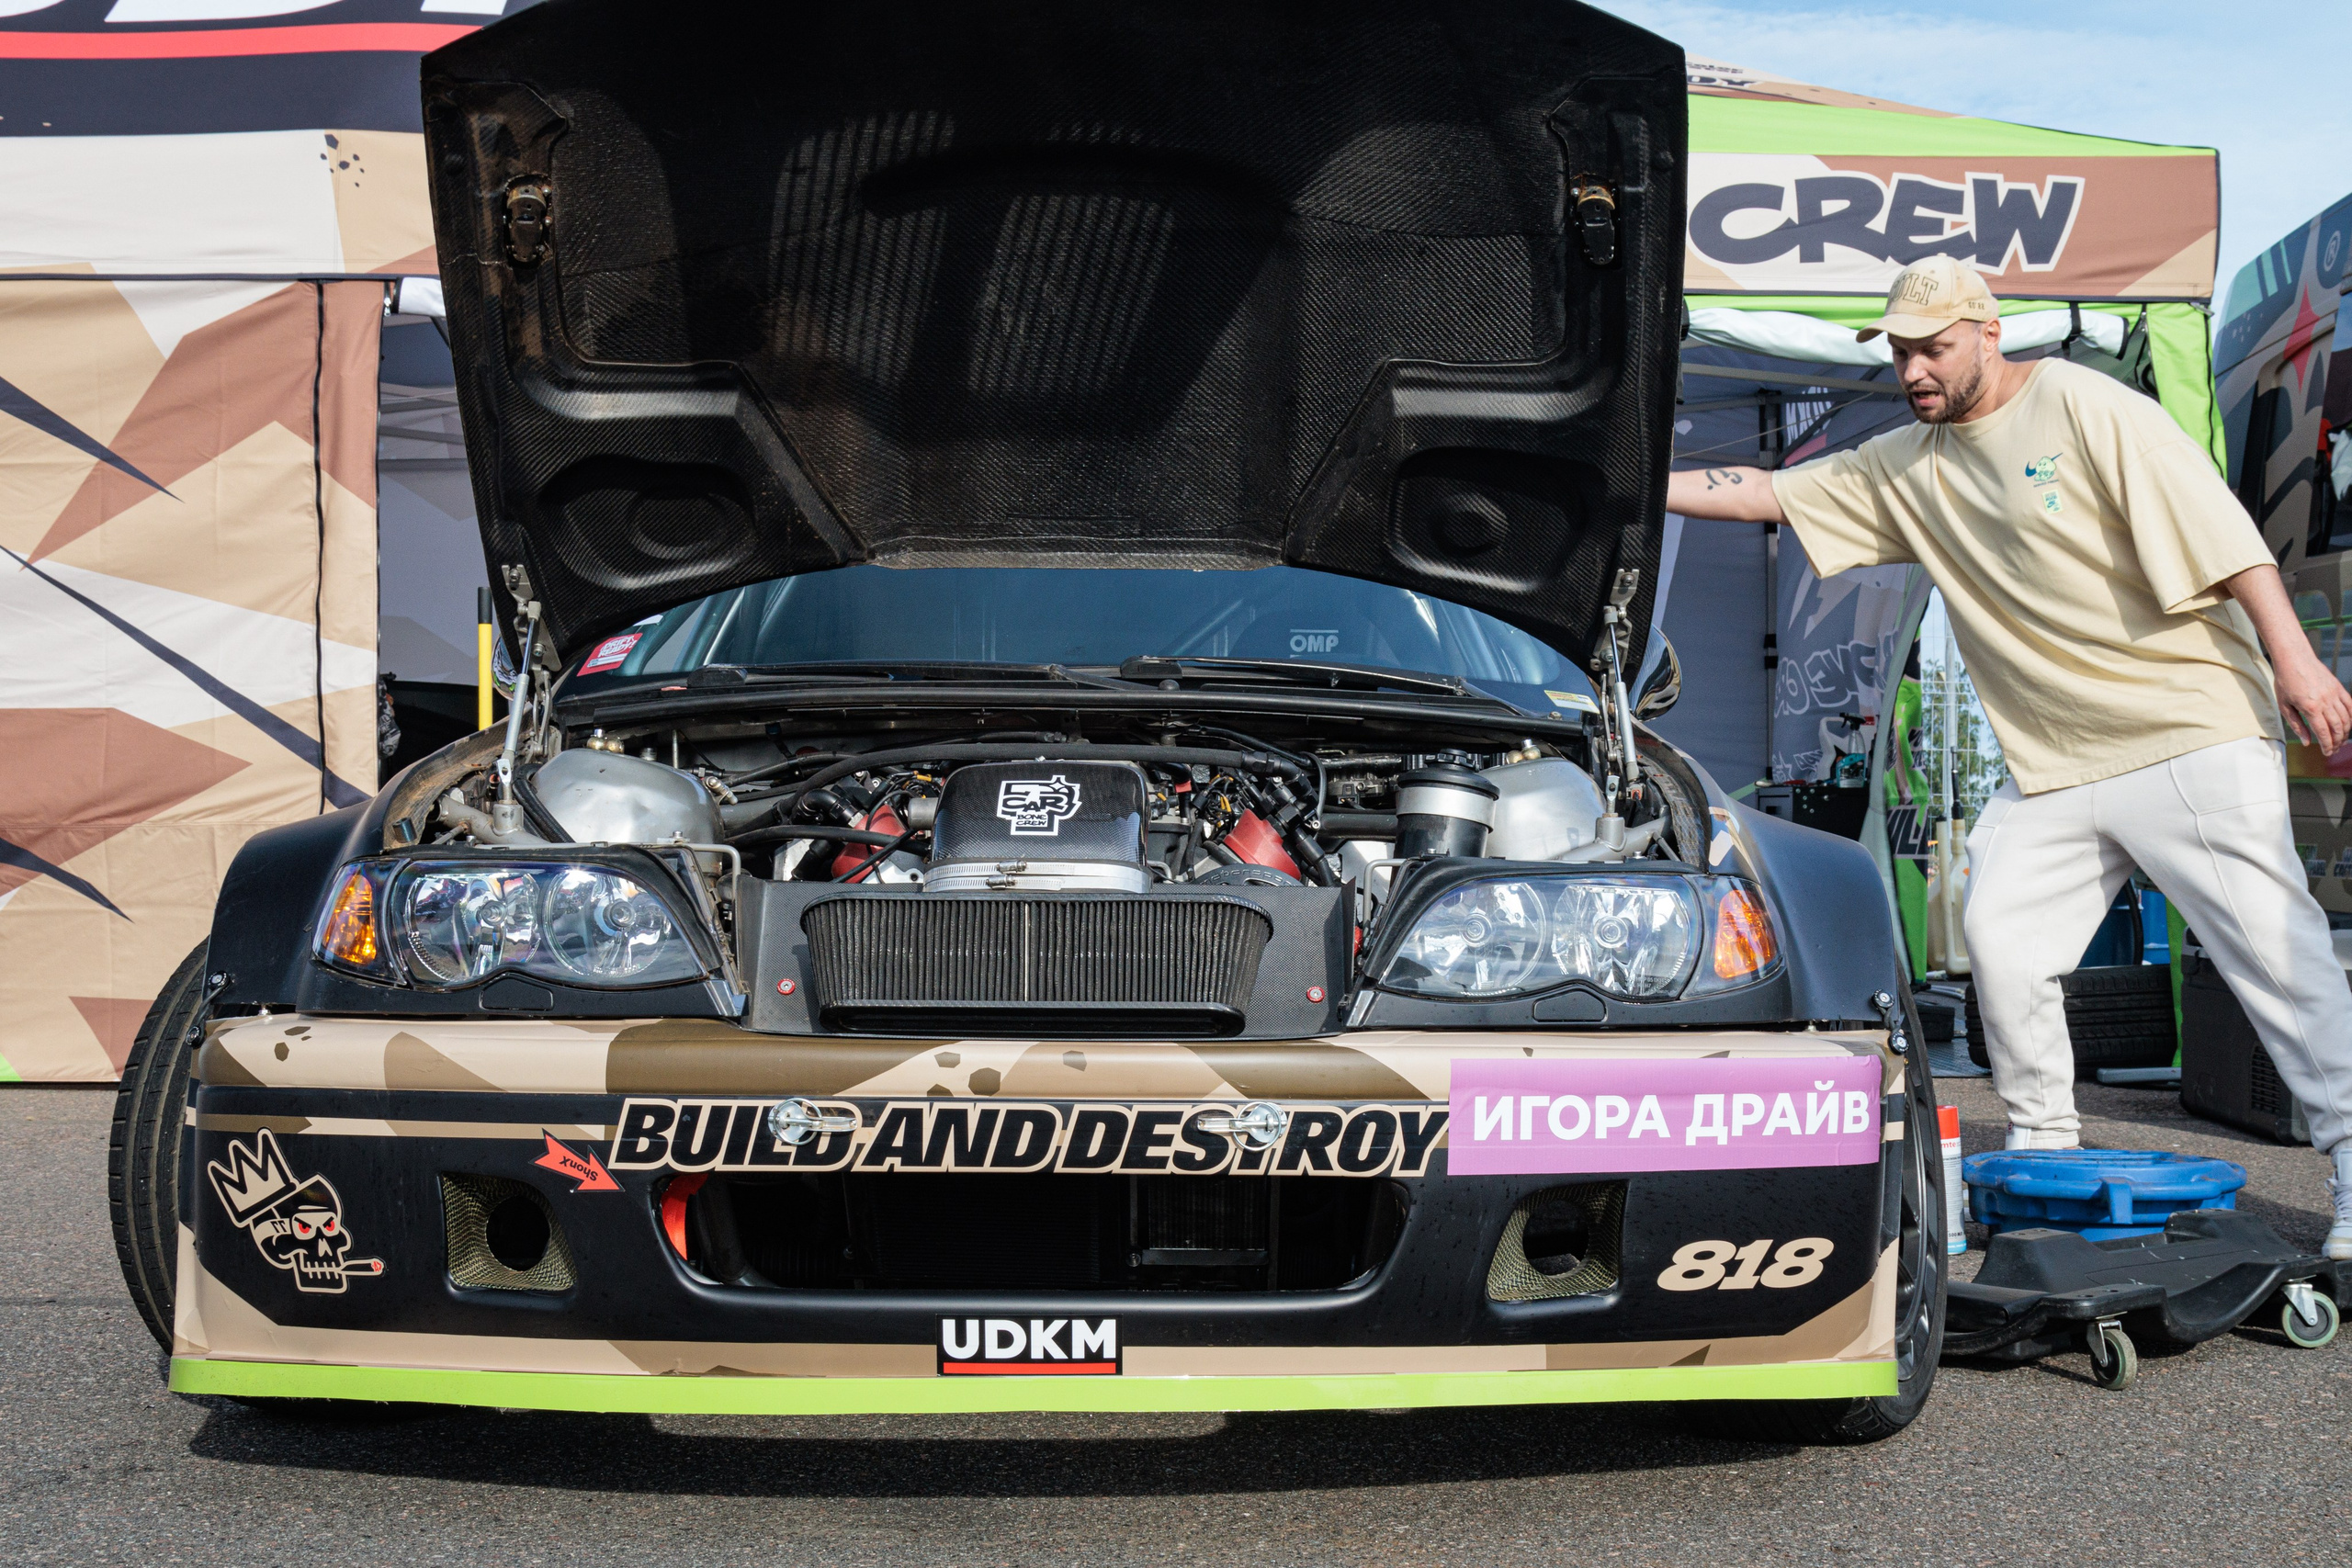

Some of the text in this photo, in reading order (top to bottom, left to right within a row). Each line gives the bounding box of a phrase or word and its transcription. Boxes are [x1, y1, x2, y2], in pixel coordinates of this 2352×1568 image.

[1688, 174, 2082, 272] CREW
[1891, 273, 1939, 306] ULT
[1289, 634, 1340, 652] OMP
[1002, 795, 1067, 813] CAR
[608, 1098, 862, 1172] BUILD
[851, 1101, 1064, 1173] AND
[1473, 1079, 1871, 1146] ИГОРА ДРАЙВ
[1657, 1236, 1835, 1292] 818
[942, 1318, 1117, 1360] UDKM
